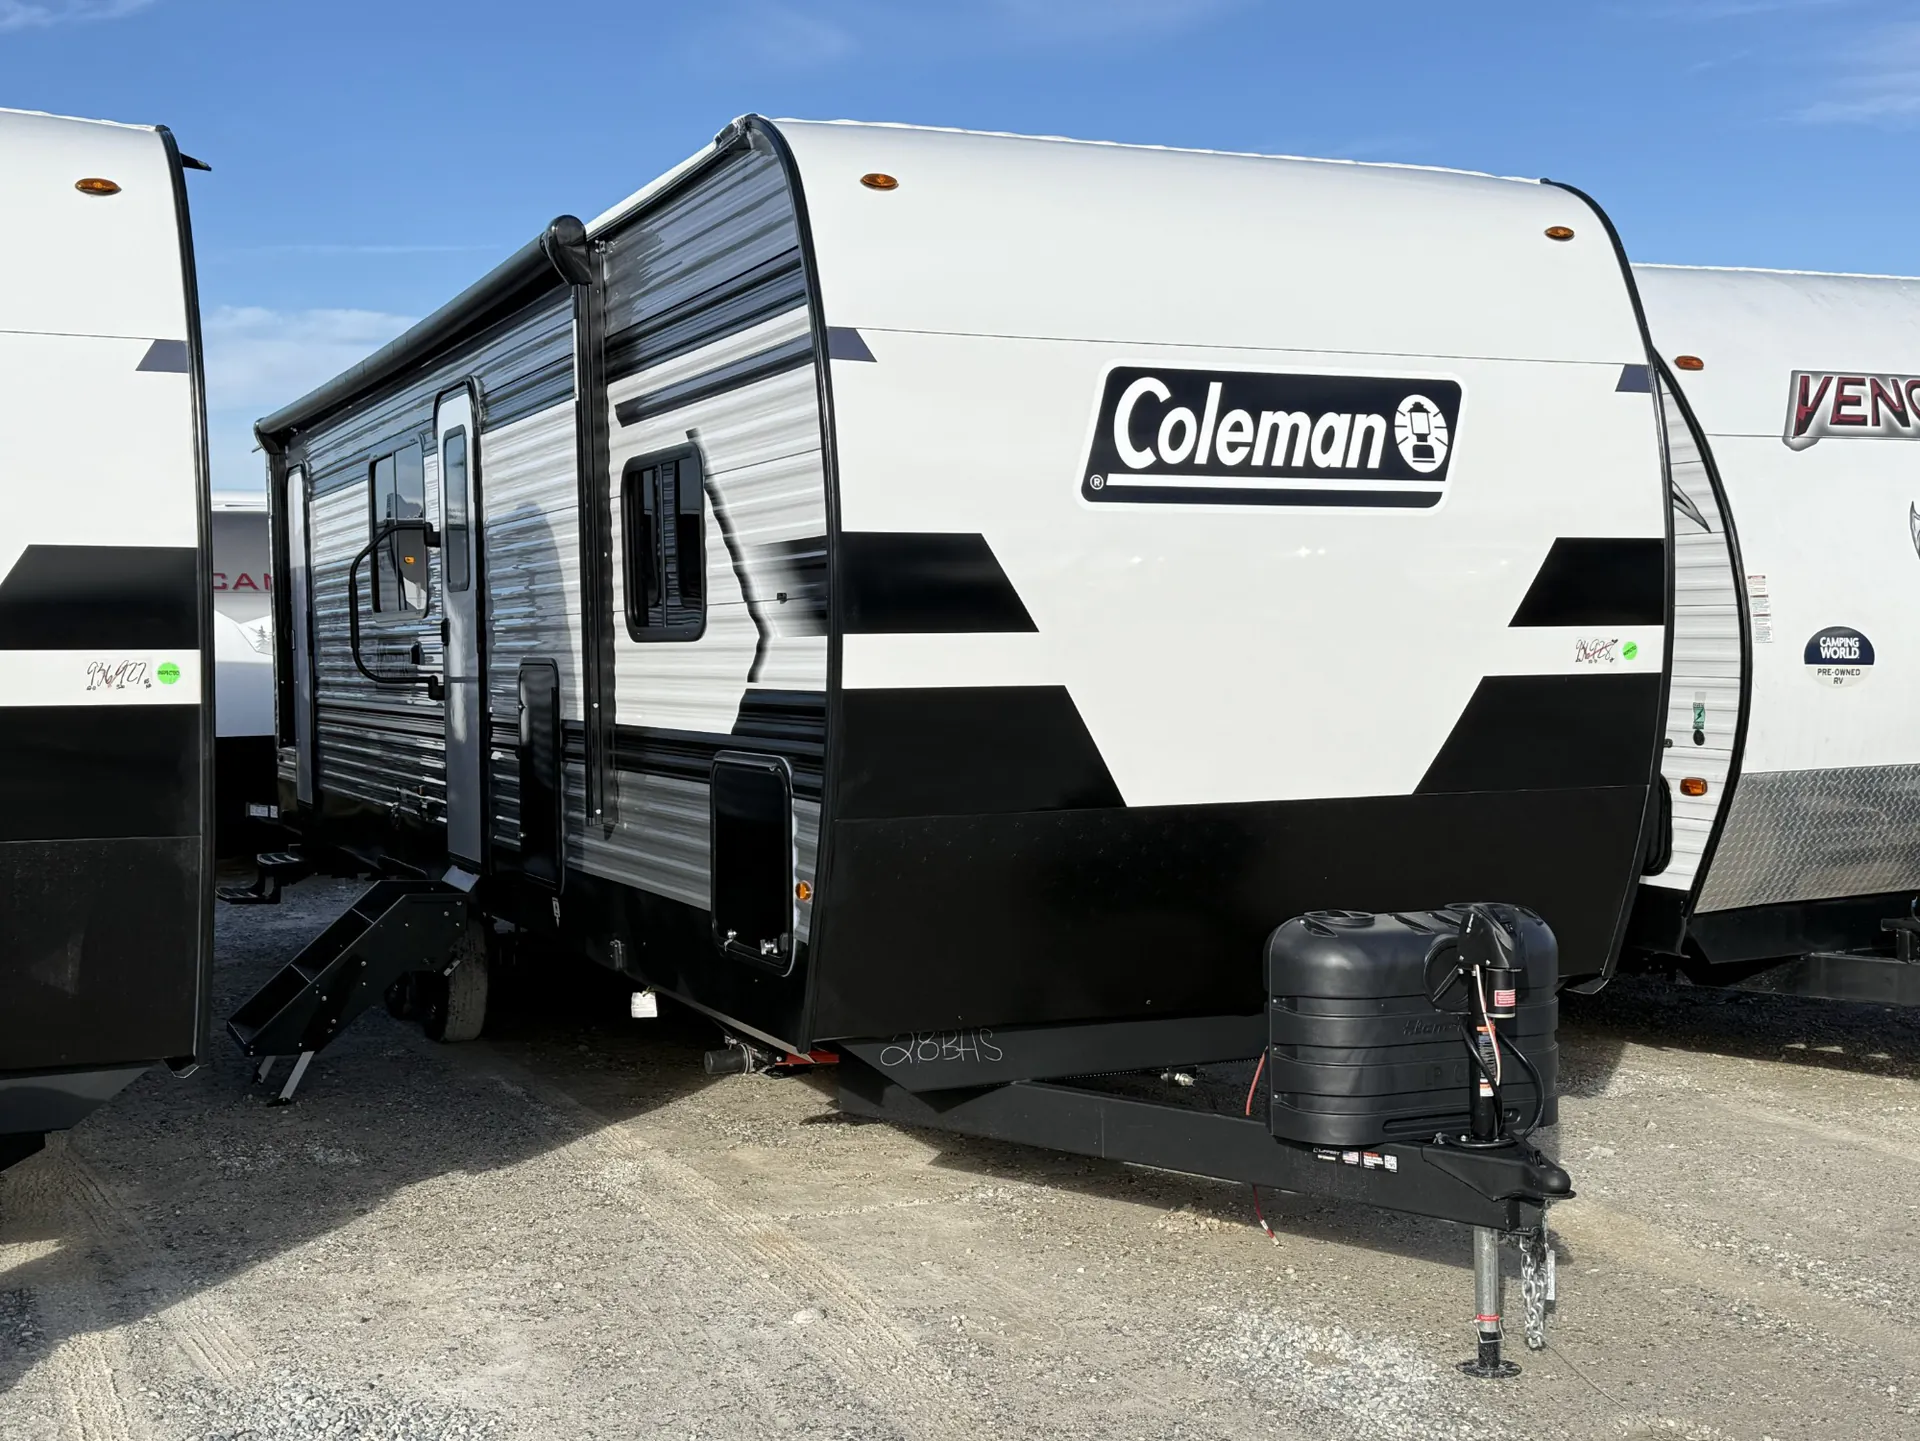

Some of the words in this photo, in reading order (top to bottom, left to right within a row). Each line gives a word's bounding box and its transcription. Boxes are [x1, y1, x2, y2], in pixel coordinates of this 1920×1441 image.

[1113, 376, 1387, 470] Coleman
[1819, 636, 1860, 647] CAMPING
[1819, 647, 1860, 659] WORLD
[87, 660, 147, 687] 936927
[1816, 668, 1861, 676] PRE-OWNED
[880, 1028, 1003, 1067] 28BHS
